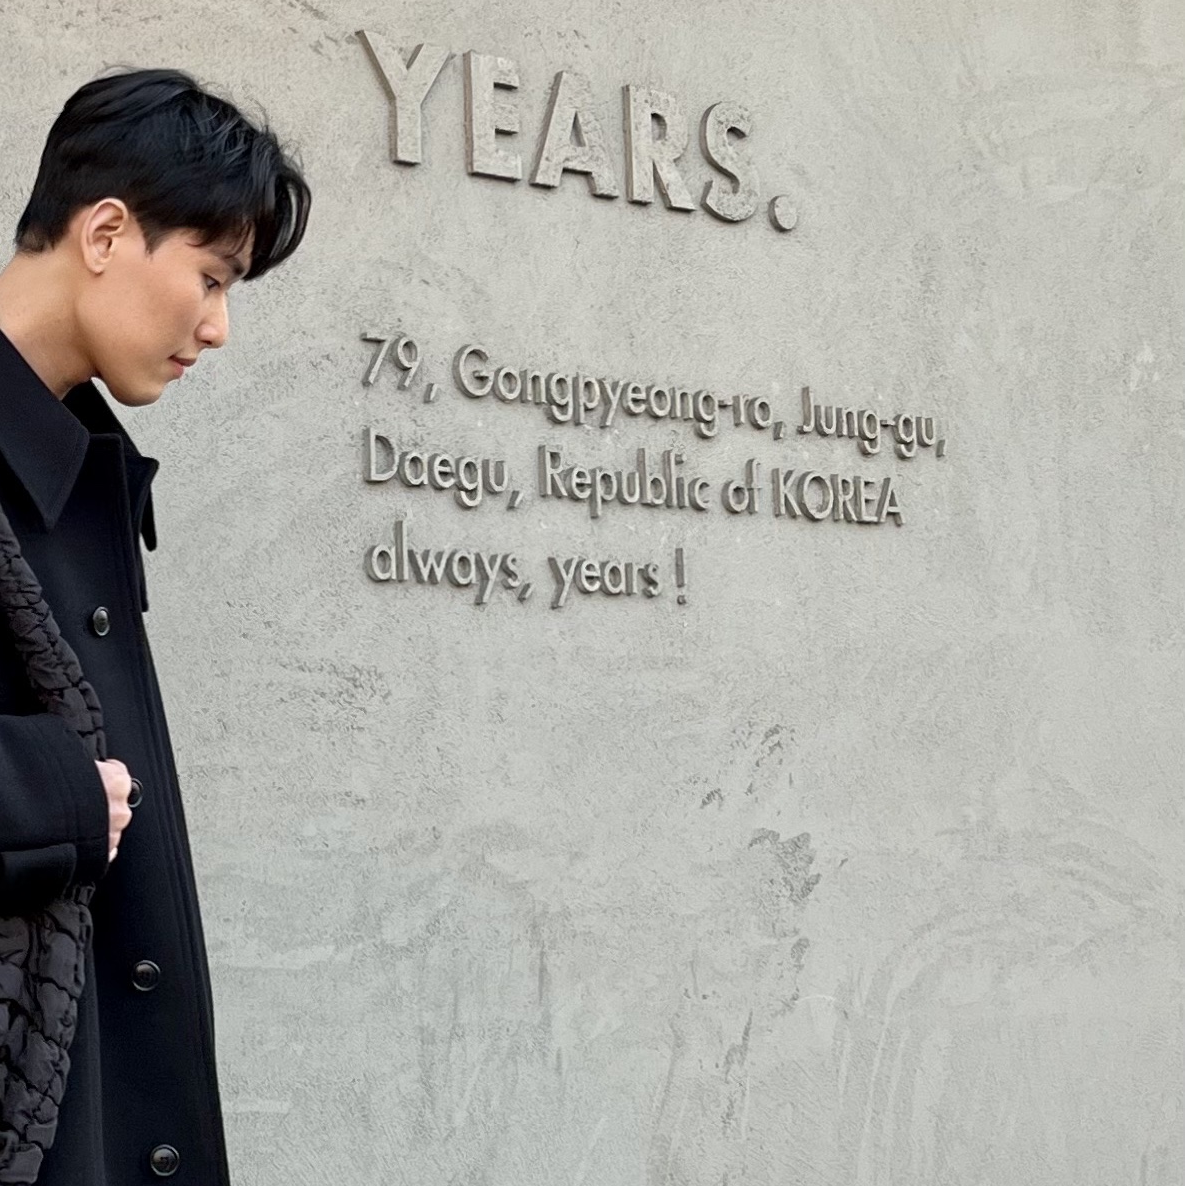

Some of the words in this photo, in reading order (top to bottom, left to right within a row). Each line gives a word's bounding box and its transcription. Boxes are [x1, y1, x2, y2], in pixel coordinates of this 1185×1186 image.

[354, 29, 799, 233] YEARS.
[359, 331, 439, 403] 79,
[451, 344, 785, 441] Gongpyeong-ro,
[795, 386, 947, 460] Jung-gu,
[363, 428, 525, 512] Daegu,
[537, 443, 711, 519] Republic
[720, 458, 762, 515] of
[770, 467, 906, 528] KOREA
[366, 519, 534, 606] always,
